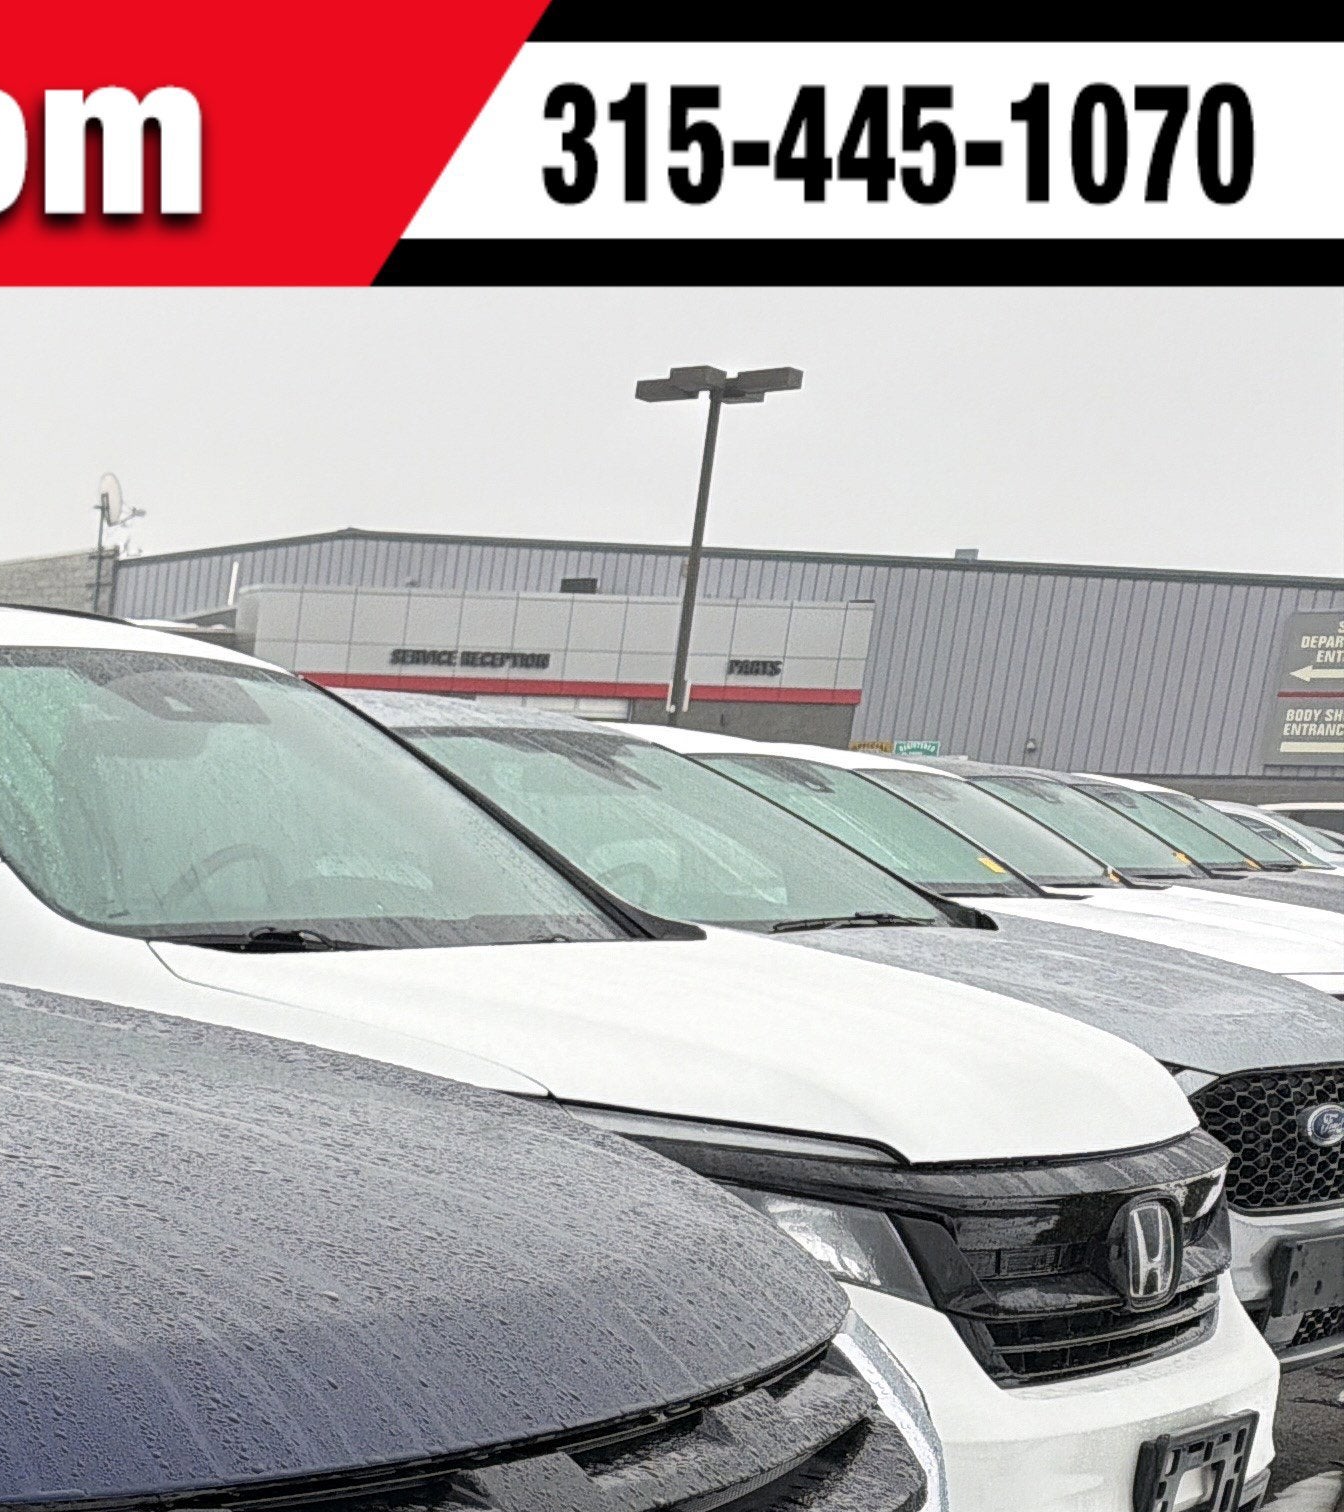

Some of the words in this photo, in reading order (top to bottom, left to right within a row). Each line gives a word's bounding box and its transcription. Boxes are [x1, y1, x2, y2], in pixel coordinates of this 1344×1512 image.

[390, 648, 458, 667] SERVICE
[728, 659, 782, 676] PARTS
[1286, 708, 1322, 722] BODY
